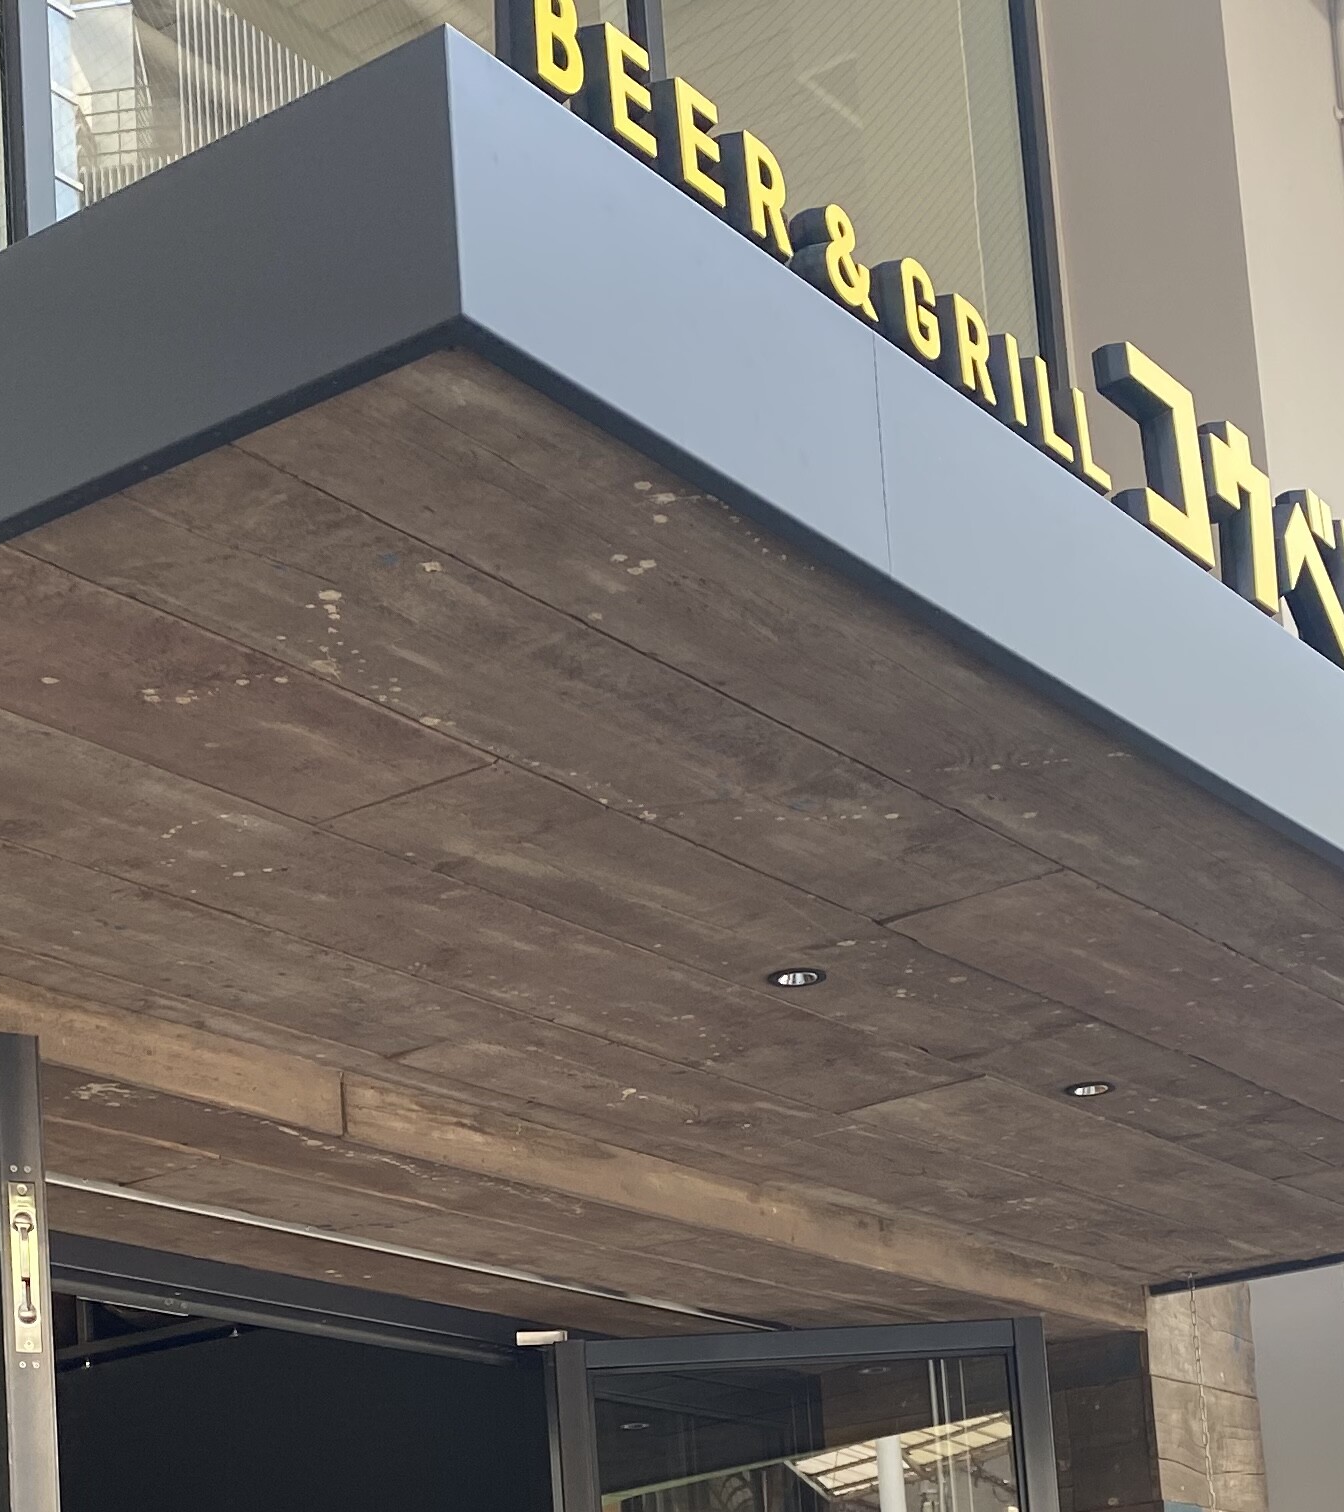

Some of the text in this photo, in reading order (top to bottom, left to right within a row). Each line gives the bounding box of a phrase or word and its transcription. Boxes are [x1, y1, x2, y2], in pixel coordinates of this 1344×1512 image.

[532, 0, 1112, 494] BEER & GRILL
